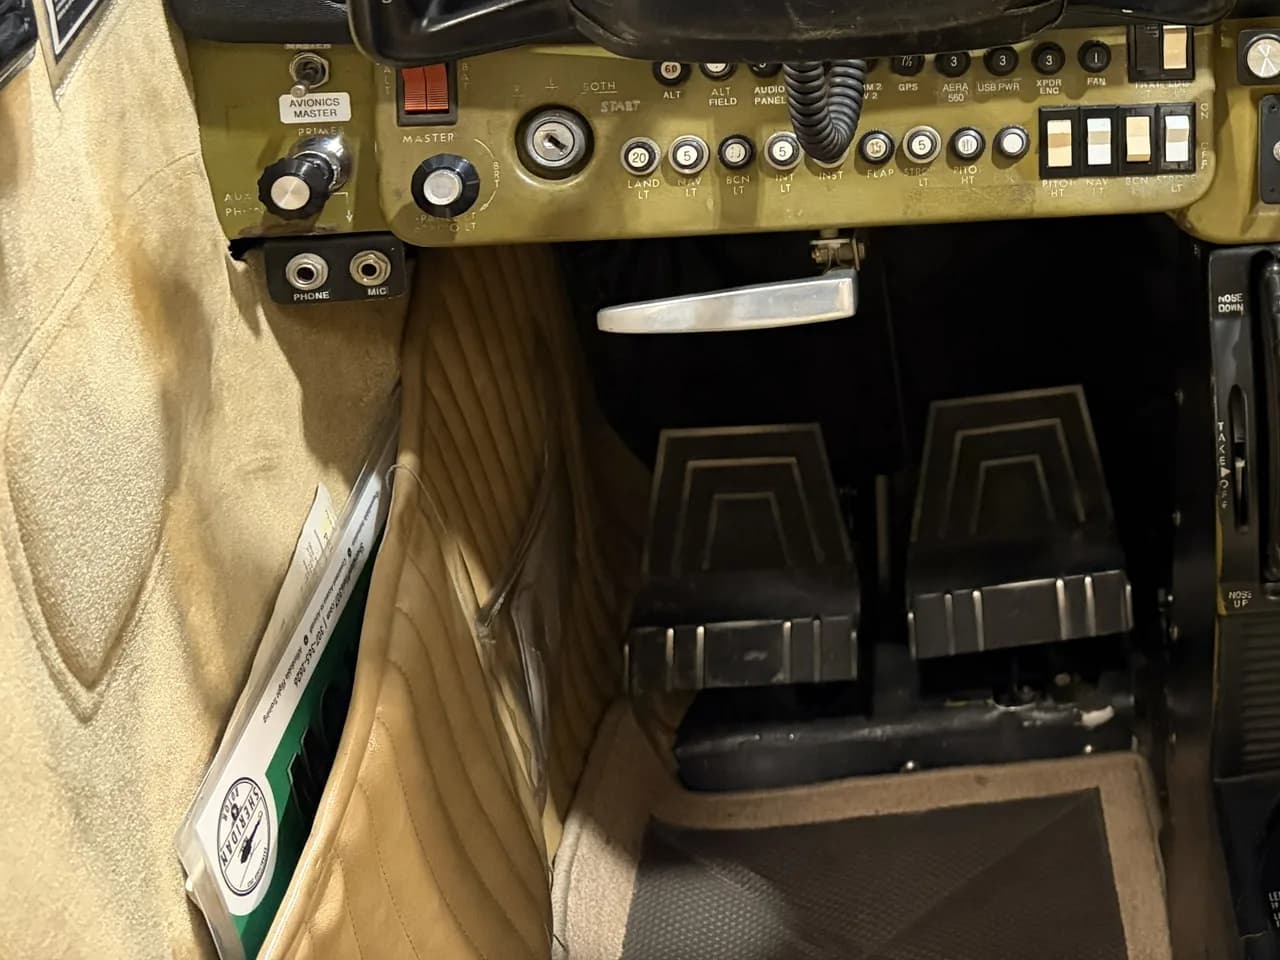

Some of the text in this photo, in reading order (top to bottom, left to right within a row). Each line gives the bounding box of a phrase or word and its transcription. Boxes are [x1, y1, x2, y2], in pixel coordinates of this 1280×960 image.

[1037, 79, 1062, 87] XPDR
[1087, 78, 1106, 86] FAN
[711, 87, 731, 96] ALT
[754, 86, 785, 94] AUDIO
[899, 83, 918, 91] GPS
[943, 83, 969, 92] AERA
[977, 82, 1020, 92] USB PWR
[1040, 87, 1059, 95] ENC
[663, 91, 681, 99] ALT
[948, 93, 964, 102] 560
[289, 97, 340, 108] AVIONICS
[709, 97, 737, 106] FIELD
[754, 96, 787, 104] PANEL
[294, 108, 337, 118] MASTER
[402, 133, 455, 143] MASTER
[294, 291, 330, 300] PHONE
[368, 287, 387, 296] MIC
[1218, 294, 1243, 303] NOSE
[1218, 303, 1244, 313] DOWN
[221, 786, 260, 866] SHERIDAN
